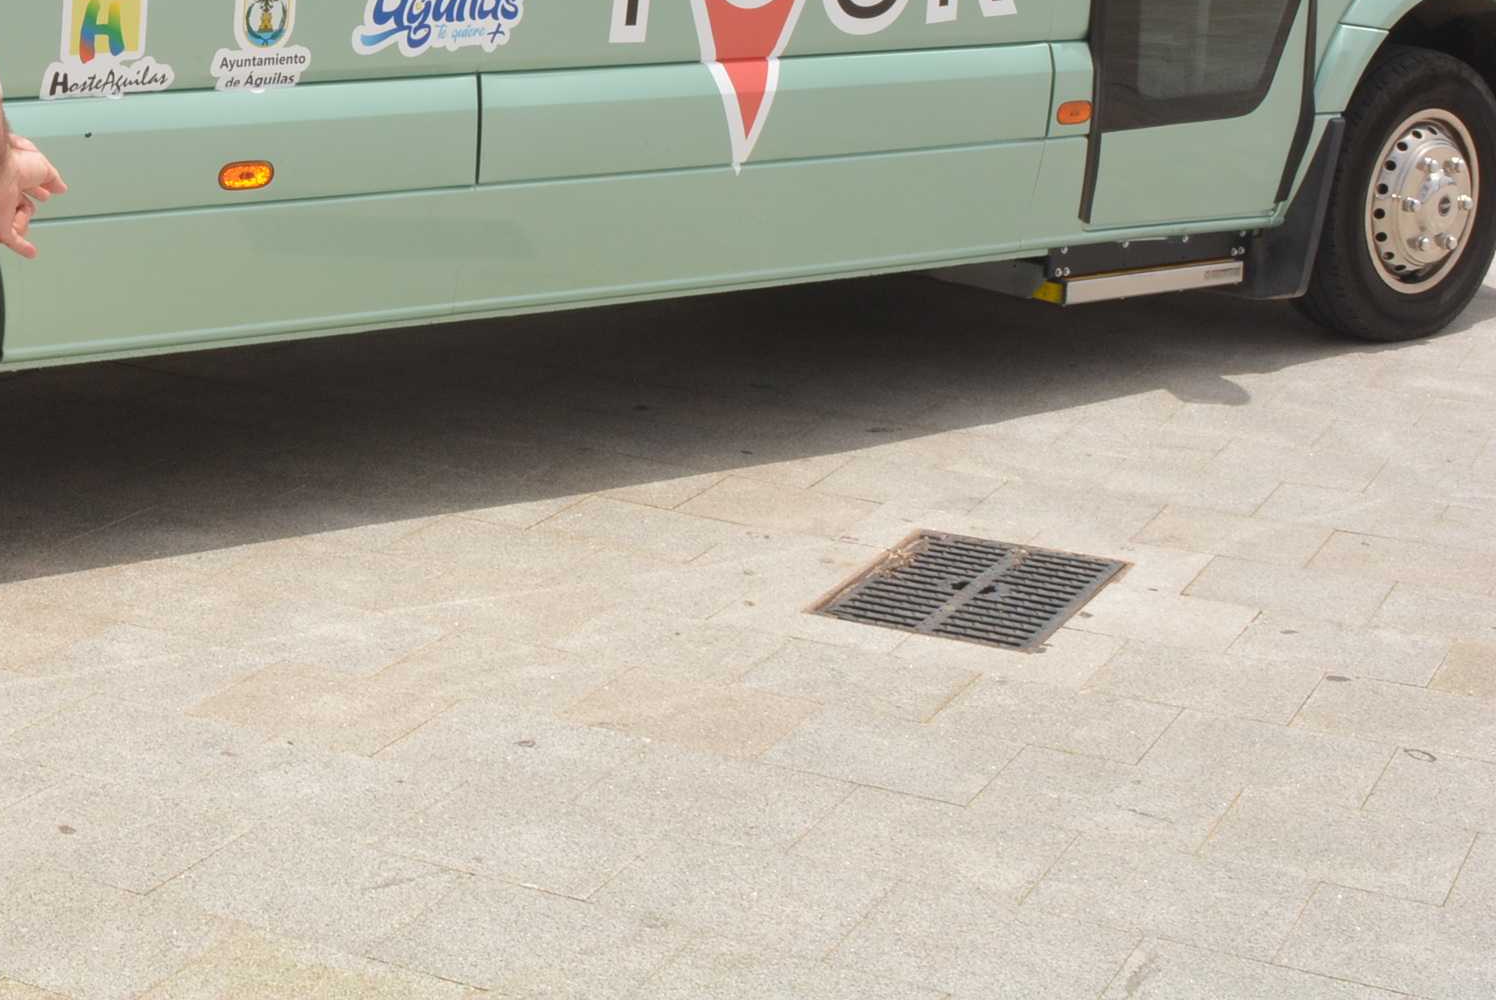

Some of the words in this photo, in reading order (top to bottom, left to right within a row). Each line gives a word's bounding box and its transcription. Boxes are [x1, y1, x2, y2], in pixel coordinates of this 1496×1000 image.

[451, 24, 485, 43] quiere
[219, 53, 306, 72] Ayuntamiento
[224, 77, 240, 88] de
[243, 71, 295, 88] Águilas
